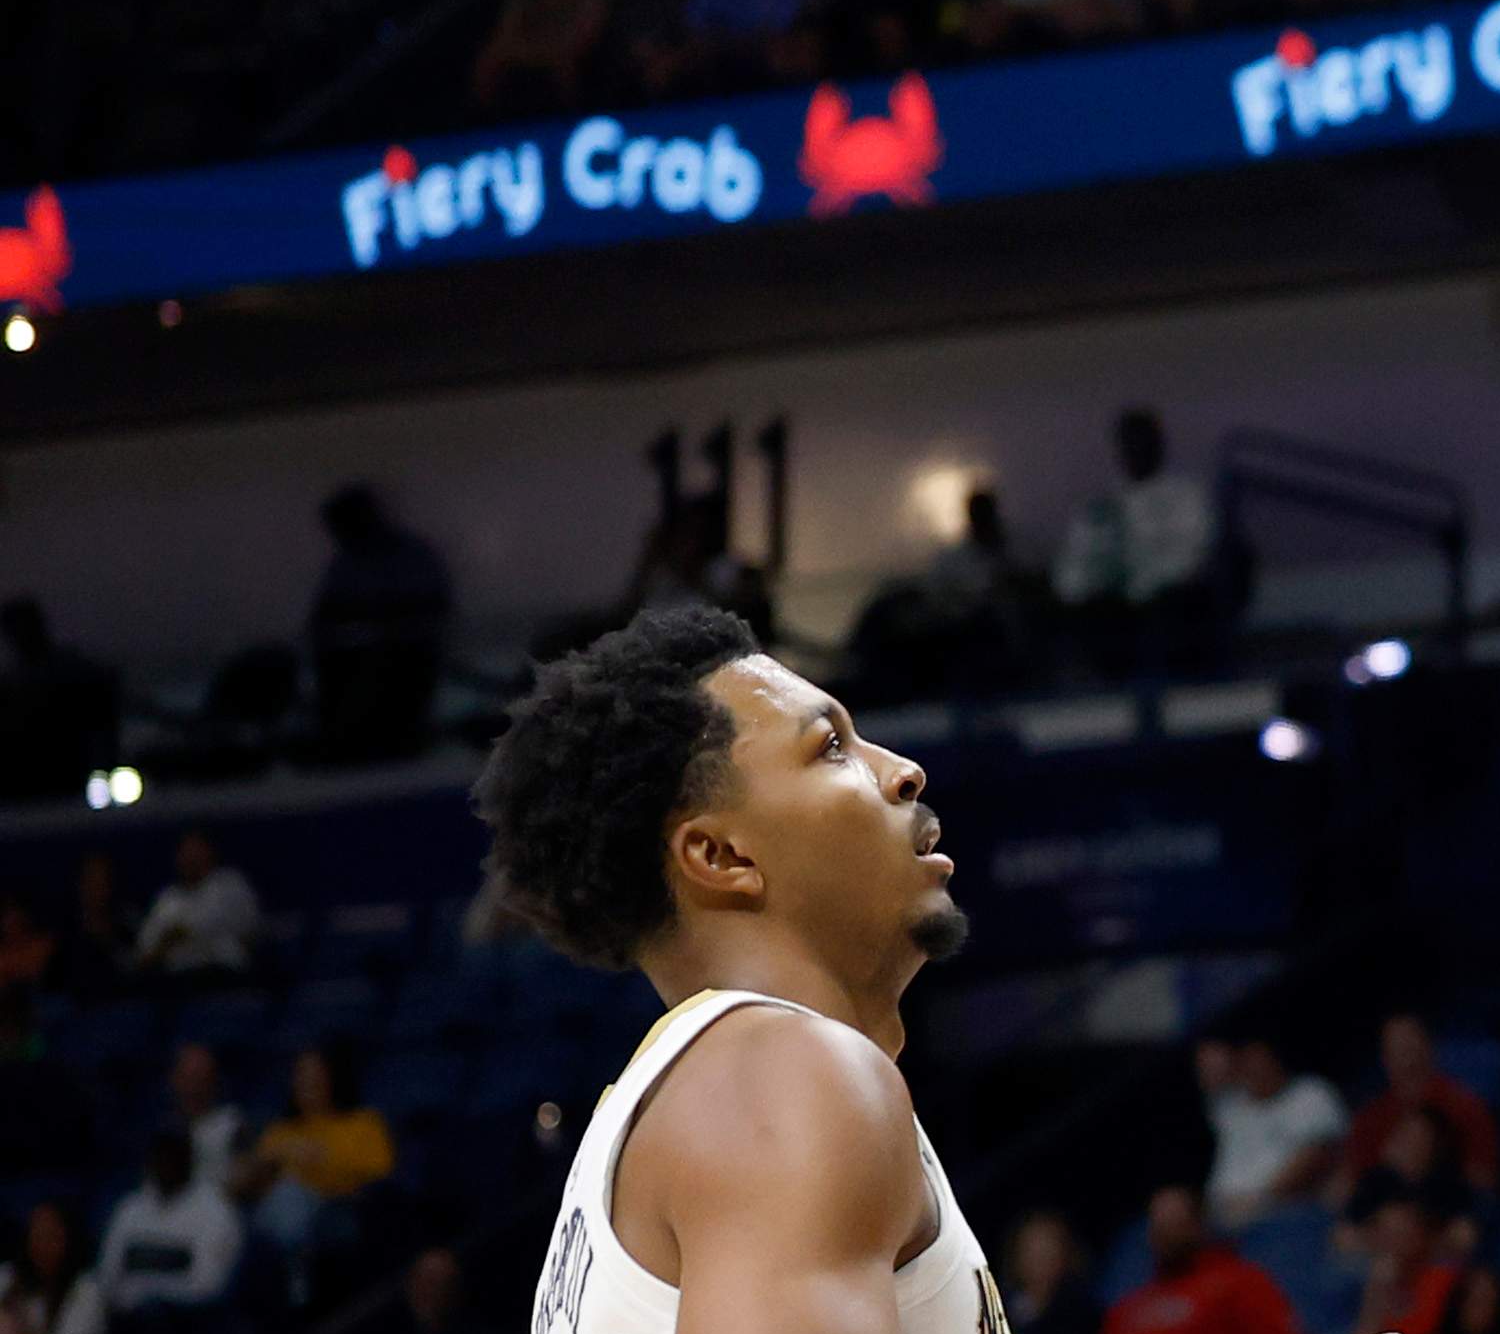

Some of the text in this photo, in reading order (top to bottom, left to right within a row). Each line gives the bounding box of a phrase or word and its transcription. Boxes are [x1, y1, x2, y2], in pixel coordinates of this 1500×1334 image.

[1234, 25, 1453, 155] Fiery
[344, 119, 762, 266] Fiery Crab
